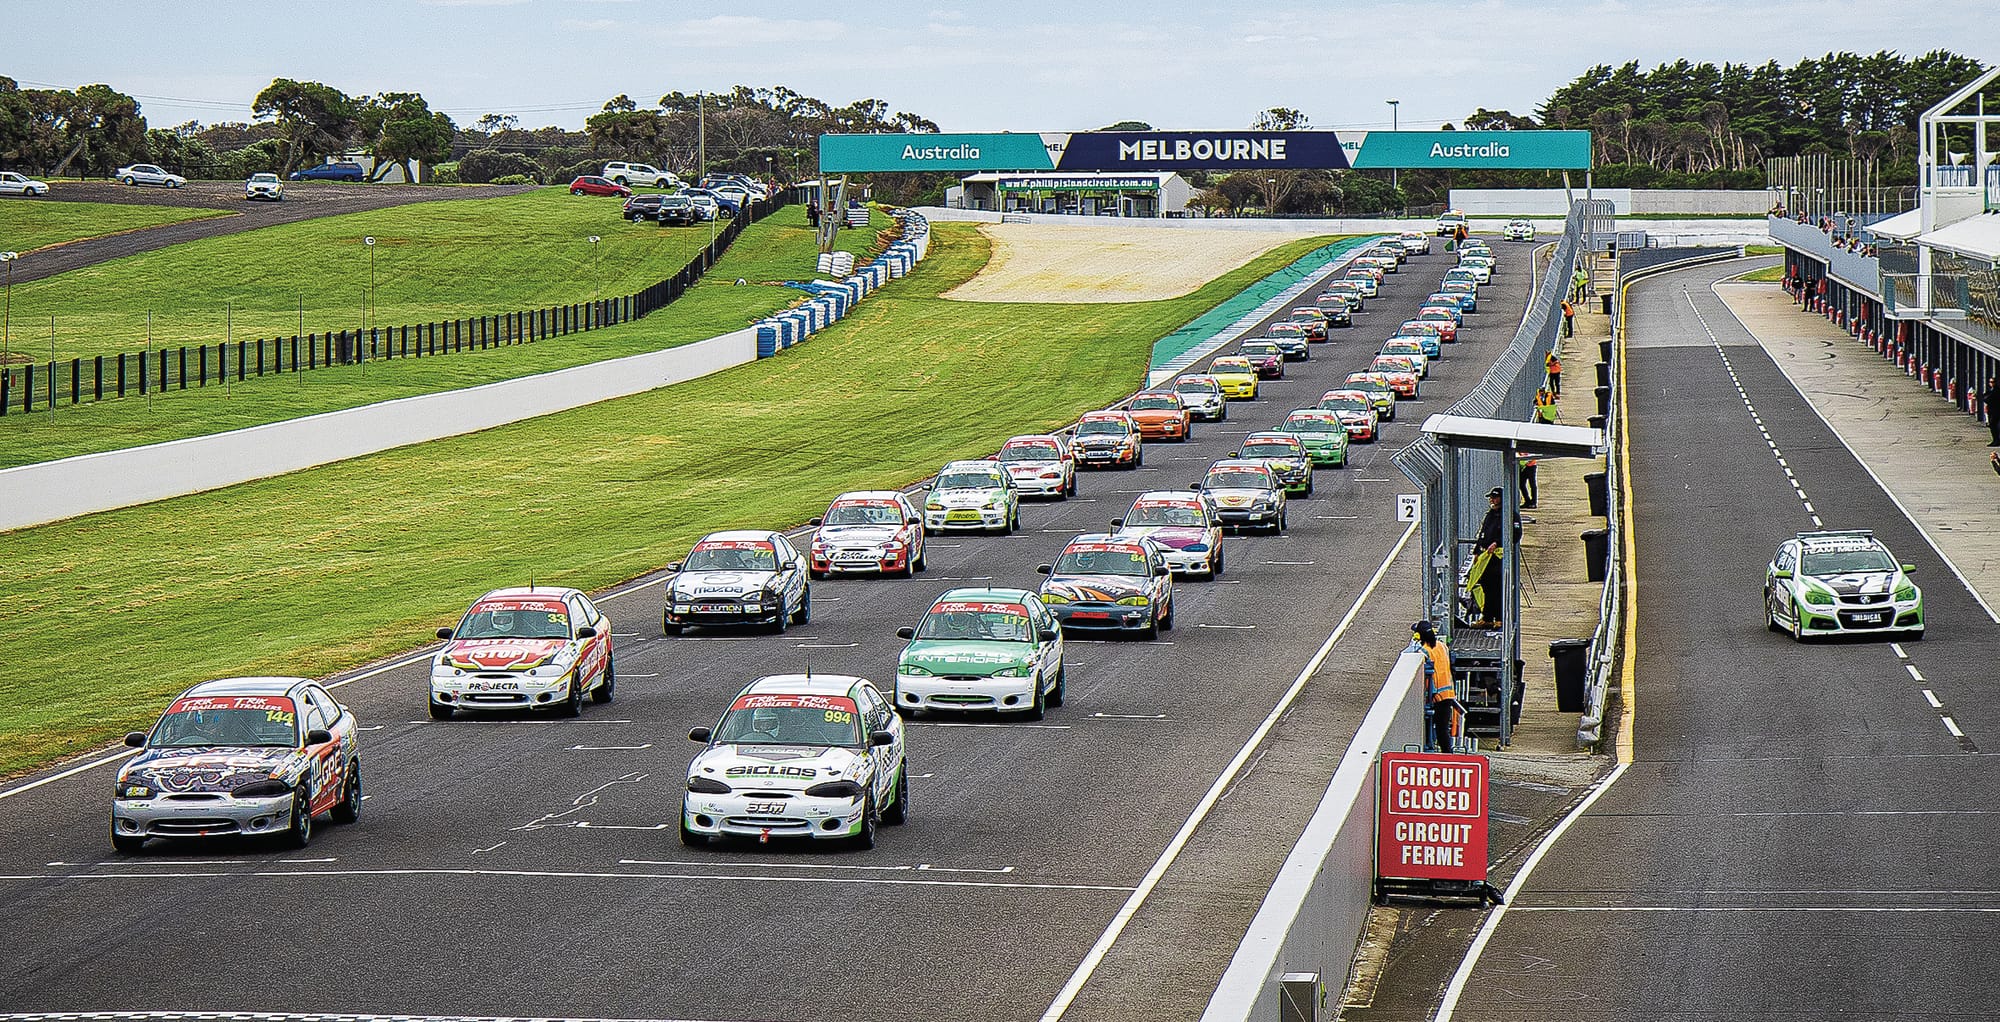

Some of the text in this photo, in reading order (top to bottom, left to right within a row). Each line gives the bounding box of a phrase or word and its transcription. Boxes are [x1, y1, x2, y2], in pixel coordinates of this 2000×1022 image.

[901, 143, 980, 160] Australia
[1044, 143, 1065, 152] MEL
[1119, 139, 1287, 161] MELBOURNE
[1340, 142, 1361, 150] MEL
[1430, 142, 1510, 158] Australia
[1005, 179, 1153, 189] www.phillipislandcircuit.com.au
[1405, 505, 1414, 518] 2
[1130, 554, 1146, 563] 84
[690, 604, 742, 613] EVOLUTION
[547, 613, 568, 624] 33
[1001, 615, 1029, 627] 117
[474, 649, 524, 659] STOP
[917, 655, 1014, 664] INTERIORS
[265, 710, 294, 724] 144
[823, 710, 852, 725] 994
[1396, 766, 1474, 788] CIRCUIT
[1398, 789, 1470, 811] CLOSED
[1395, 821, 1473, 844] CIRCUIT
[1402, 845, 1464, 867] FERME
